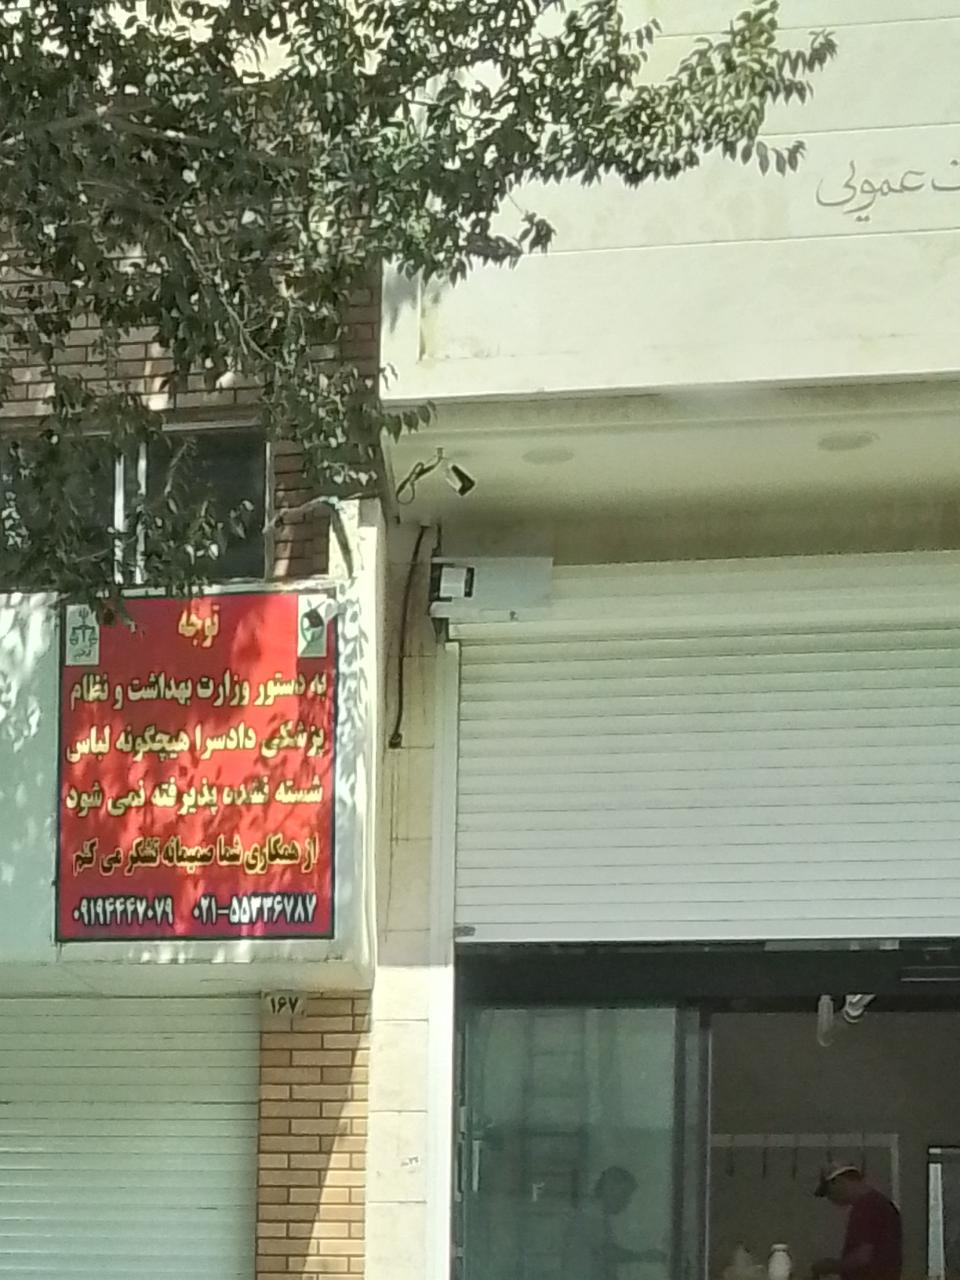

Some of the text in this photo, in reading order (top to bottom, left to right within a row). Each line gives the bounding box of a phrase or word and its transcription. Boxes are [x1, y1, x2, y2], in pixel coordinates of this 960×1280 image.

[178, 604, 220, 648] توجه
[70, 670, 327, 711] به دستور وزارت بهداشت و نظام
[66, 721, 324, 763] پزشکی دادسرا هیچگونه لباس
[66, 774, 323, 817] شسته نشده پذیرفته نمی شود
[100, 847, 123, 876] می
[124, 836, 160, 876] تشکر
[161, 835, 215, 874] صمیمانه
[217, 833, 243, 866] شما
[244, 832, 300, 875] همکاری
[301, 832, 319, 874] از
[73, 896, 174, 926] ۰۹۱۹۴۴۴۷۰۷۹
[270, 995, 300, 1015] ۱۶۷
